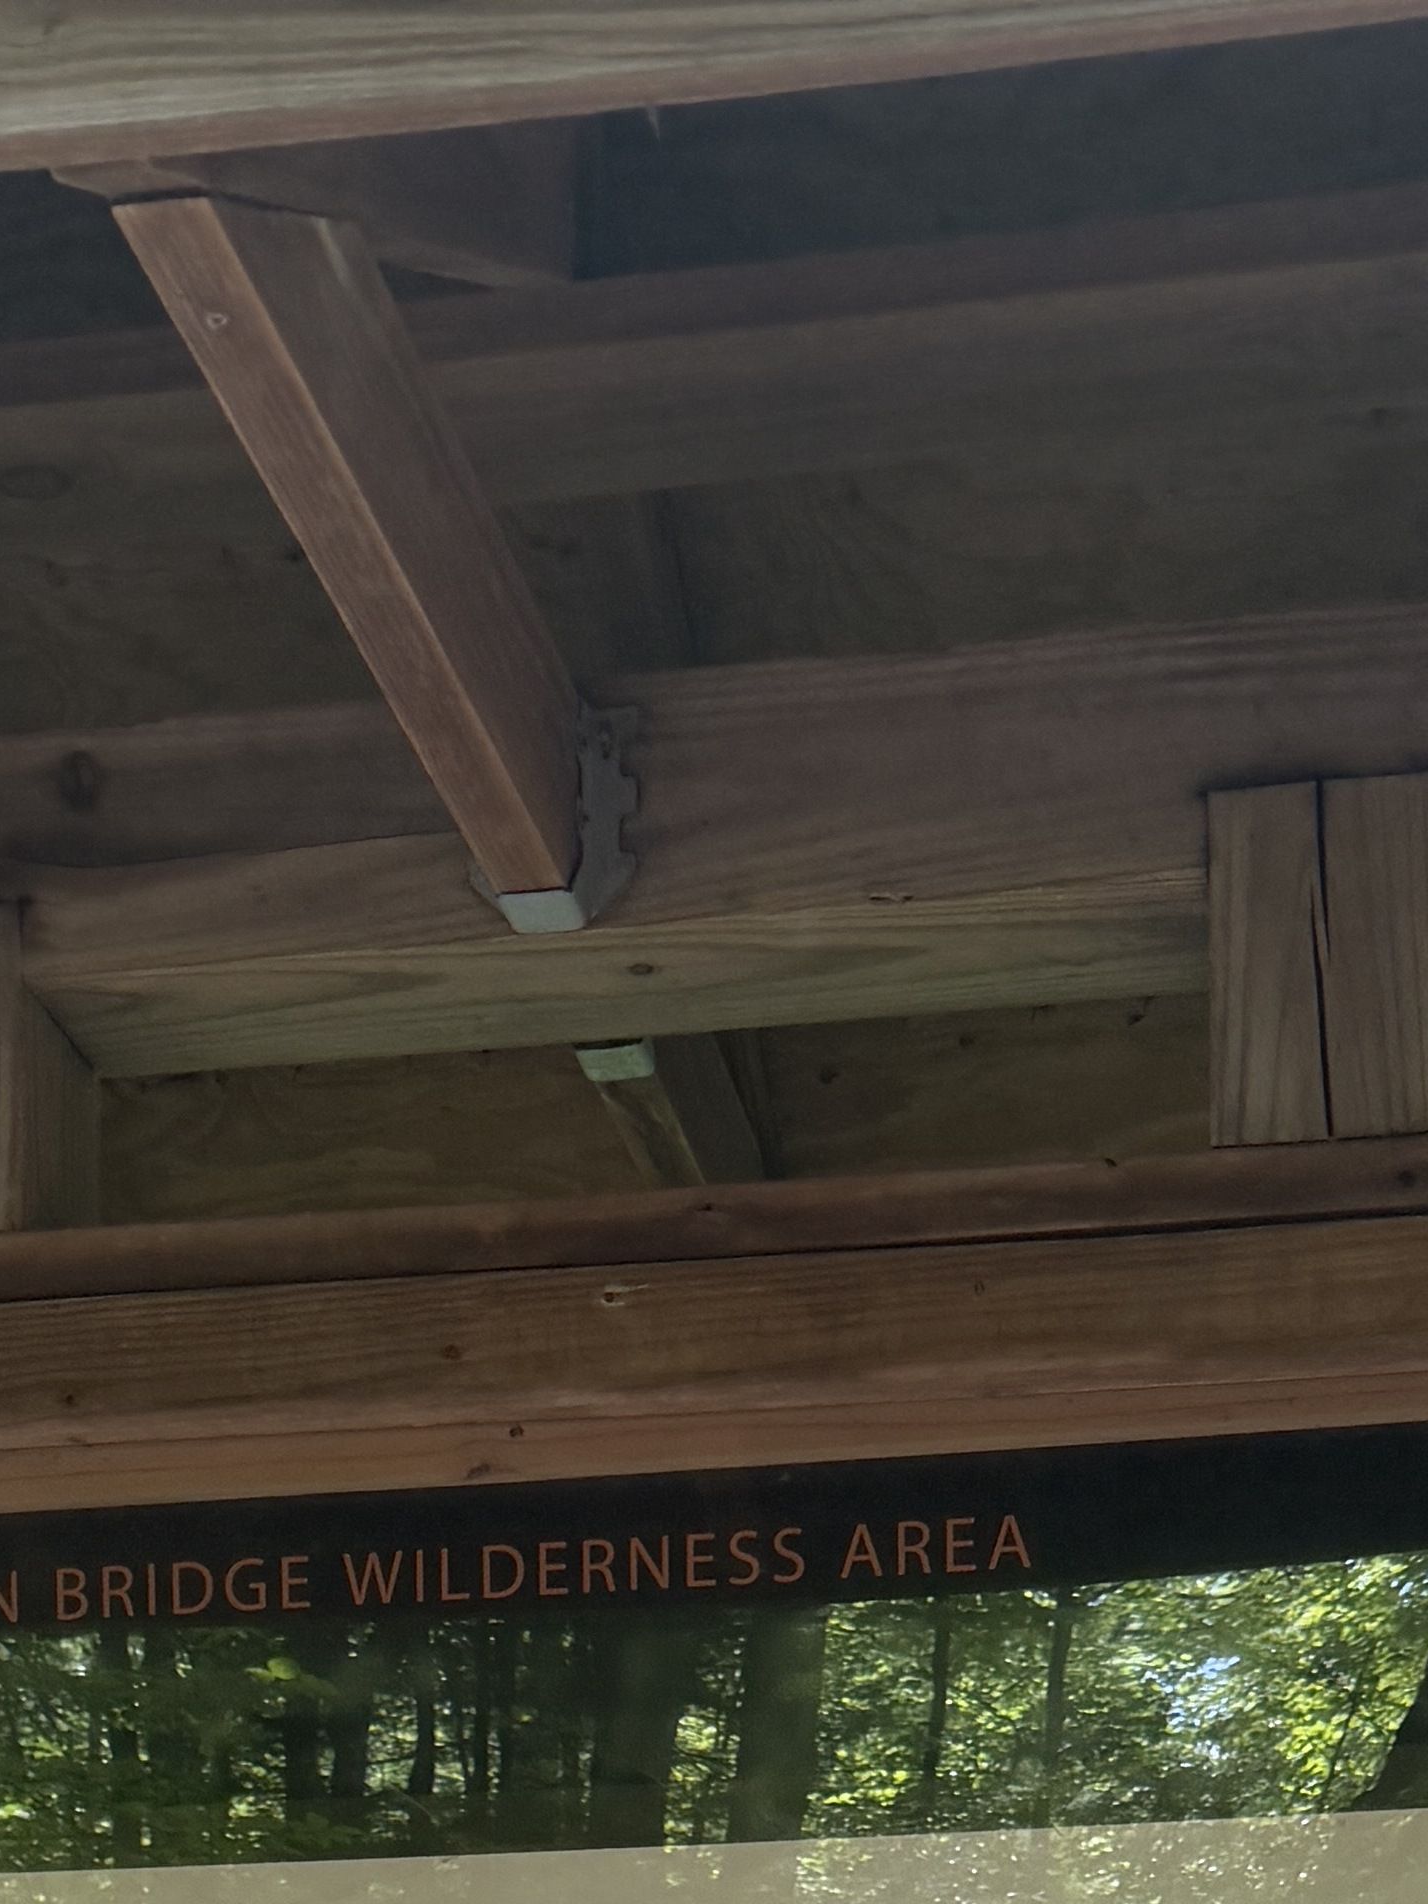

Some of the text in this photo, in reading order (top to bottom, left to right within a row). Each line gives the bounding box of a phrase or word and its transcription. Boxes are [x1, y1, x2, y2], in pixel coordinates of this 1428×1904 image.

[56, 1555, 311, 1621] BRIDGE
[344, 1523, 806, 1605] WILDERNESS
[841, 1513, 1032, 1581] AREA
